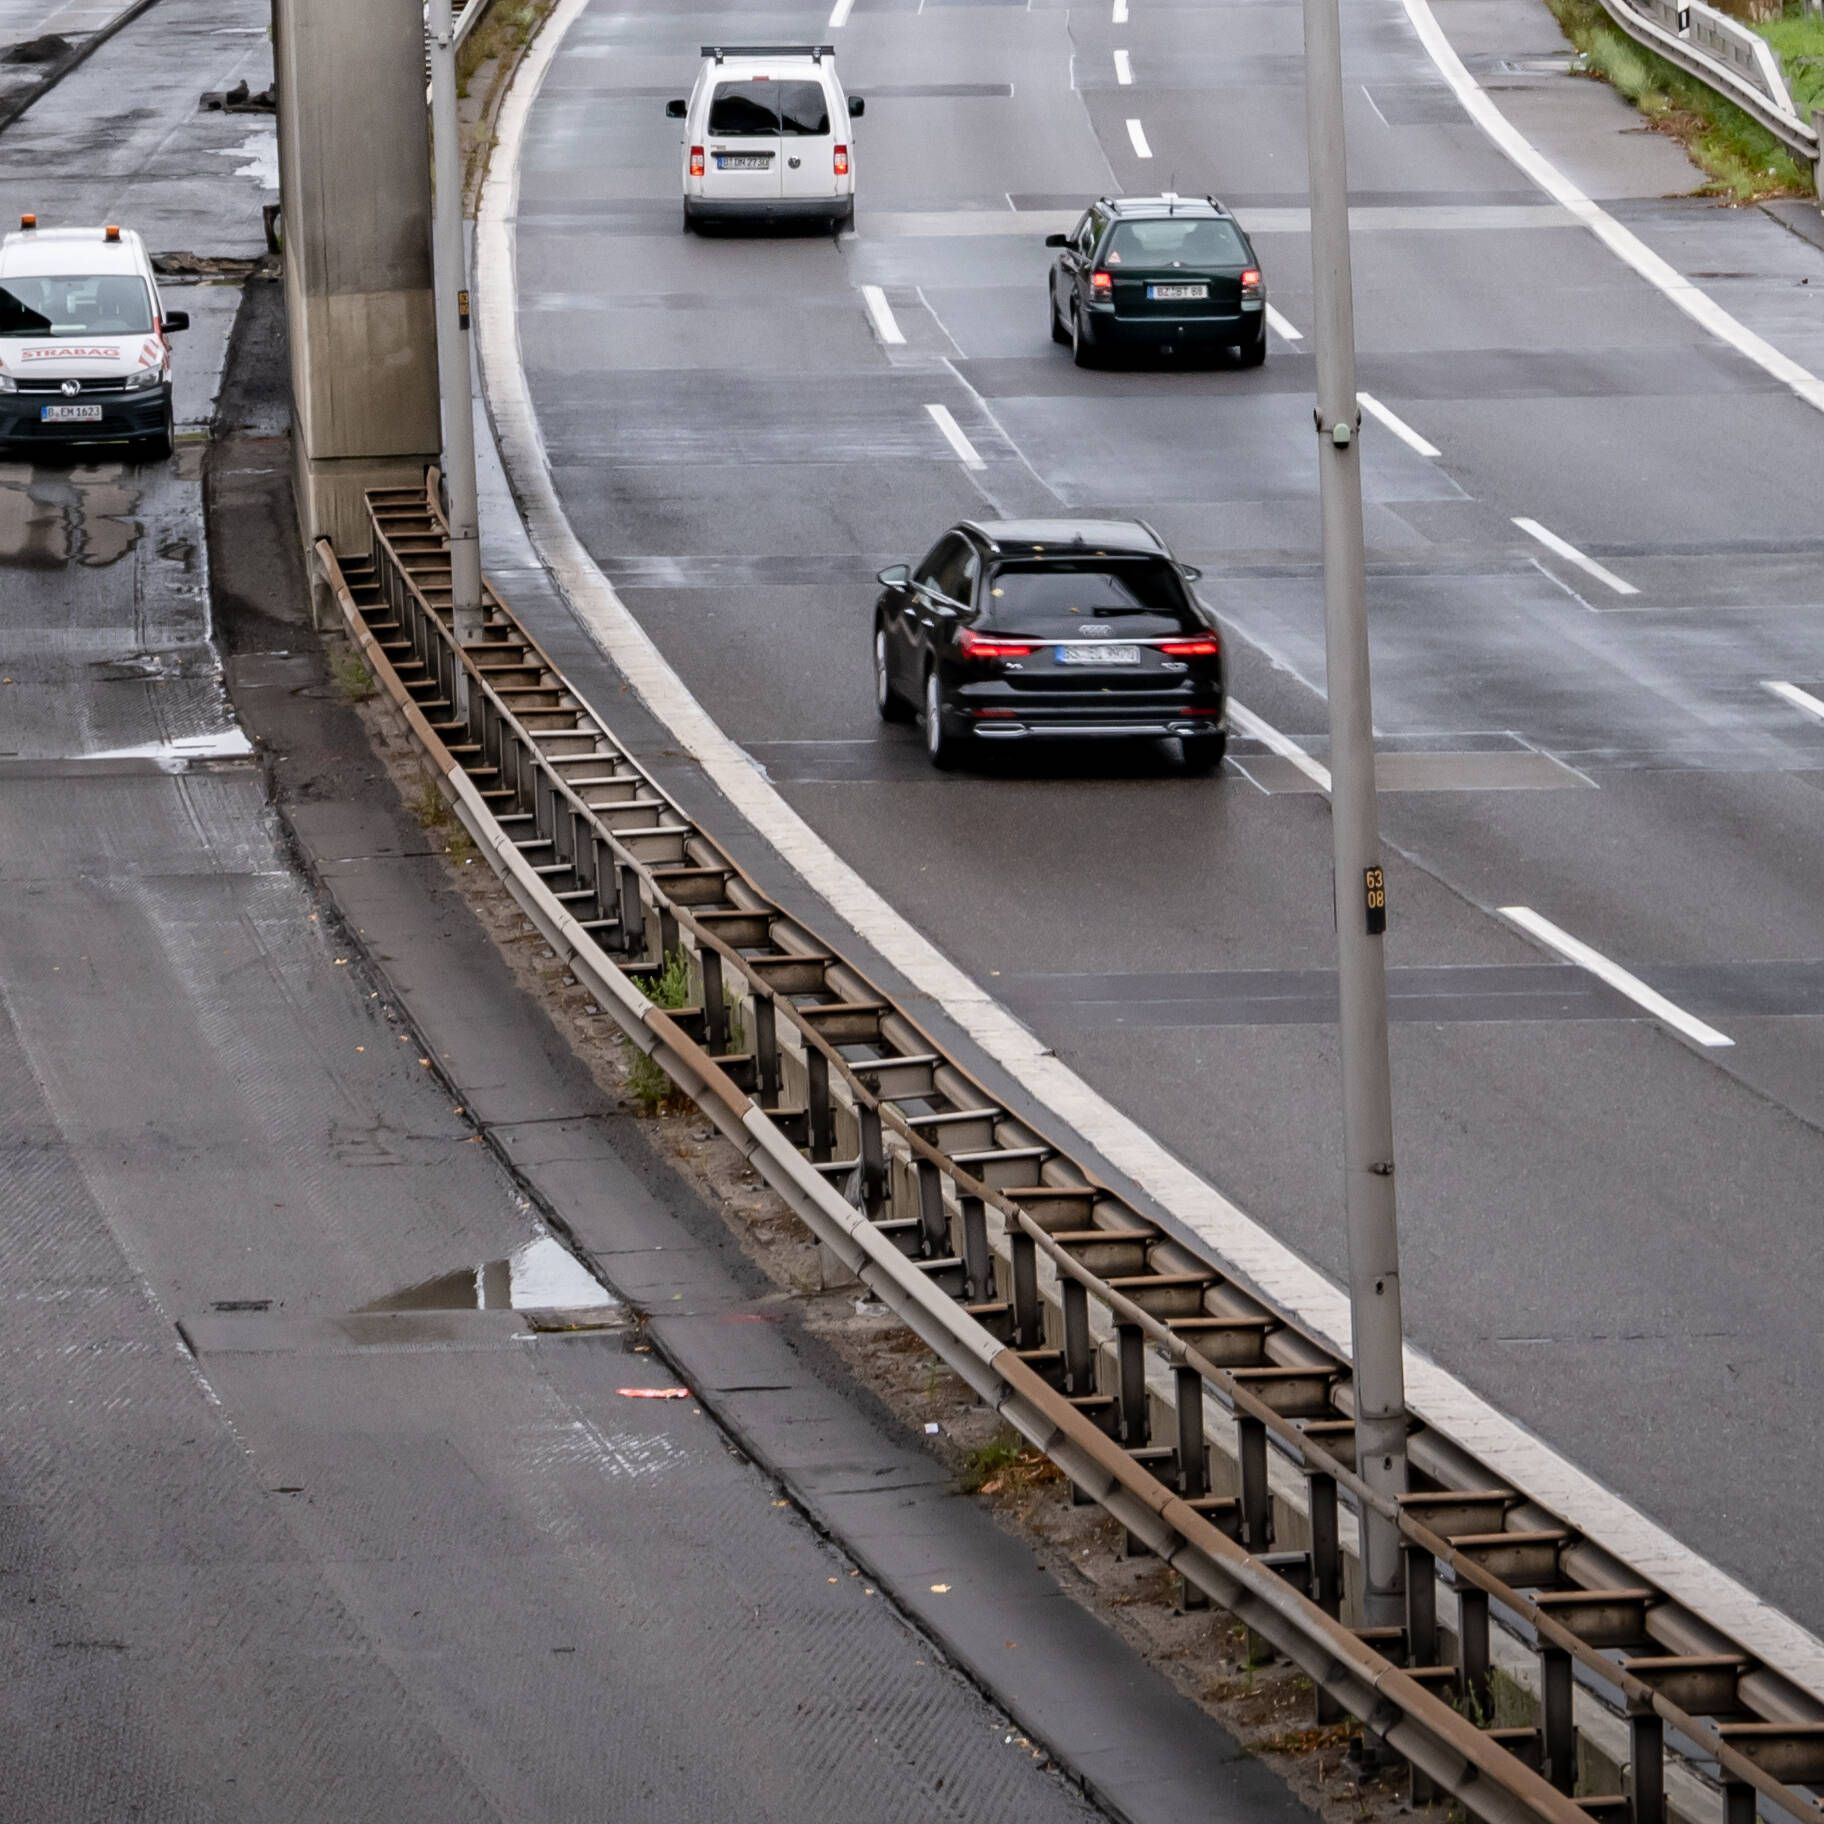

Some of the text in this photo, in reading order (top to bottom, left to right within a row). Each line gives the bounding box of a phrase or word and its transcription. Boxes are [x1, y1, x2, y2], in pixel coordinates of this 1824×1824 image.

[21, 348, 120, 359] STRABAG
[77, 406, 100, 417] 1623
[1367, 870, 1383, 888] 63
[1368, 890, 1384, 908] 08
